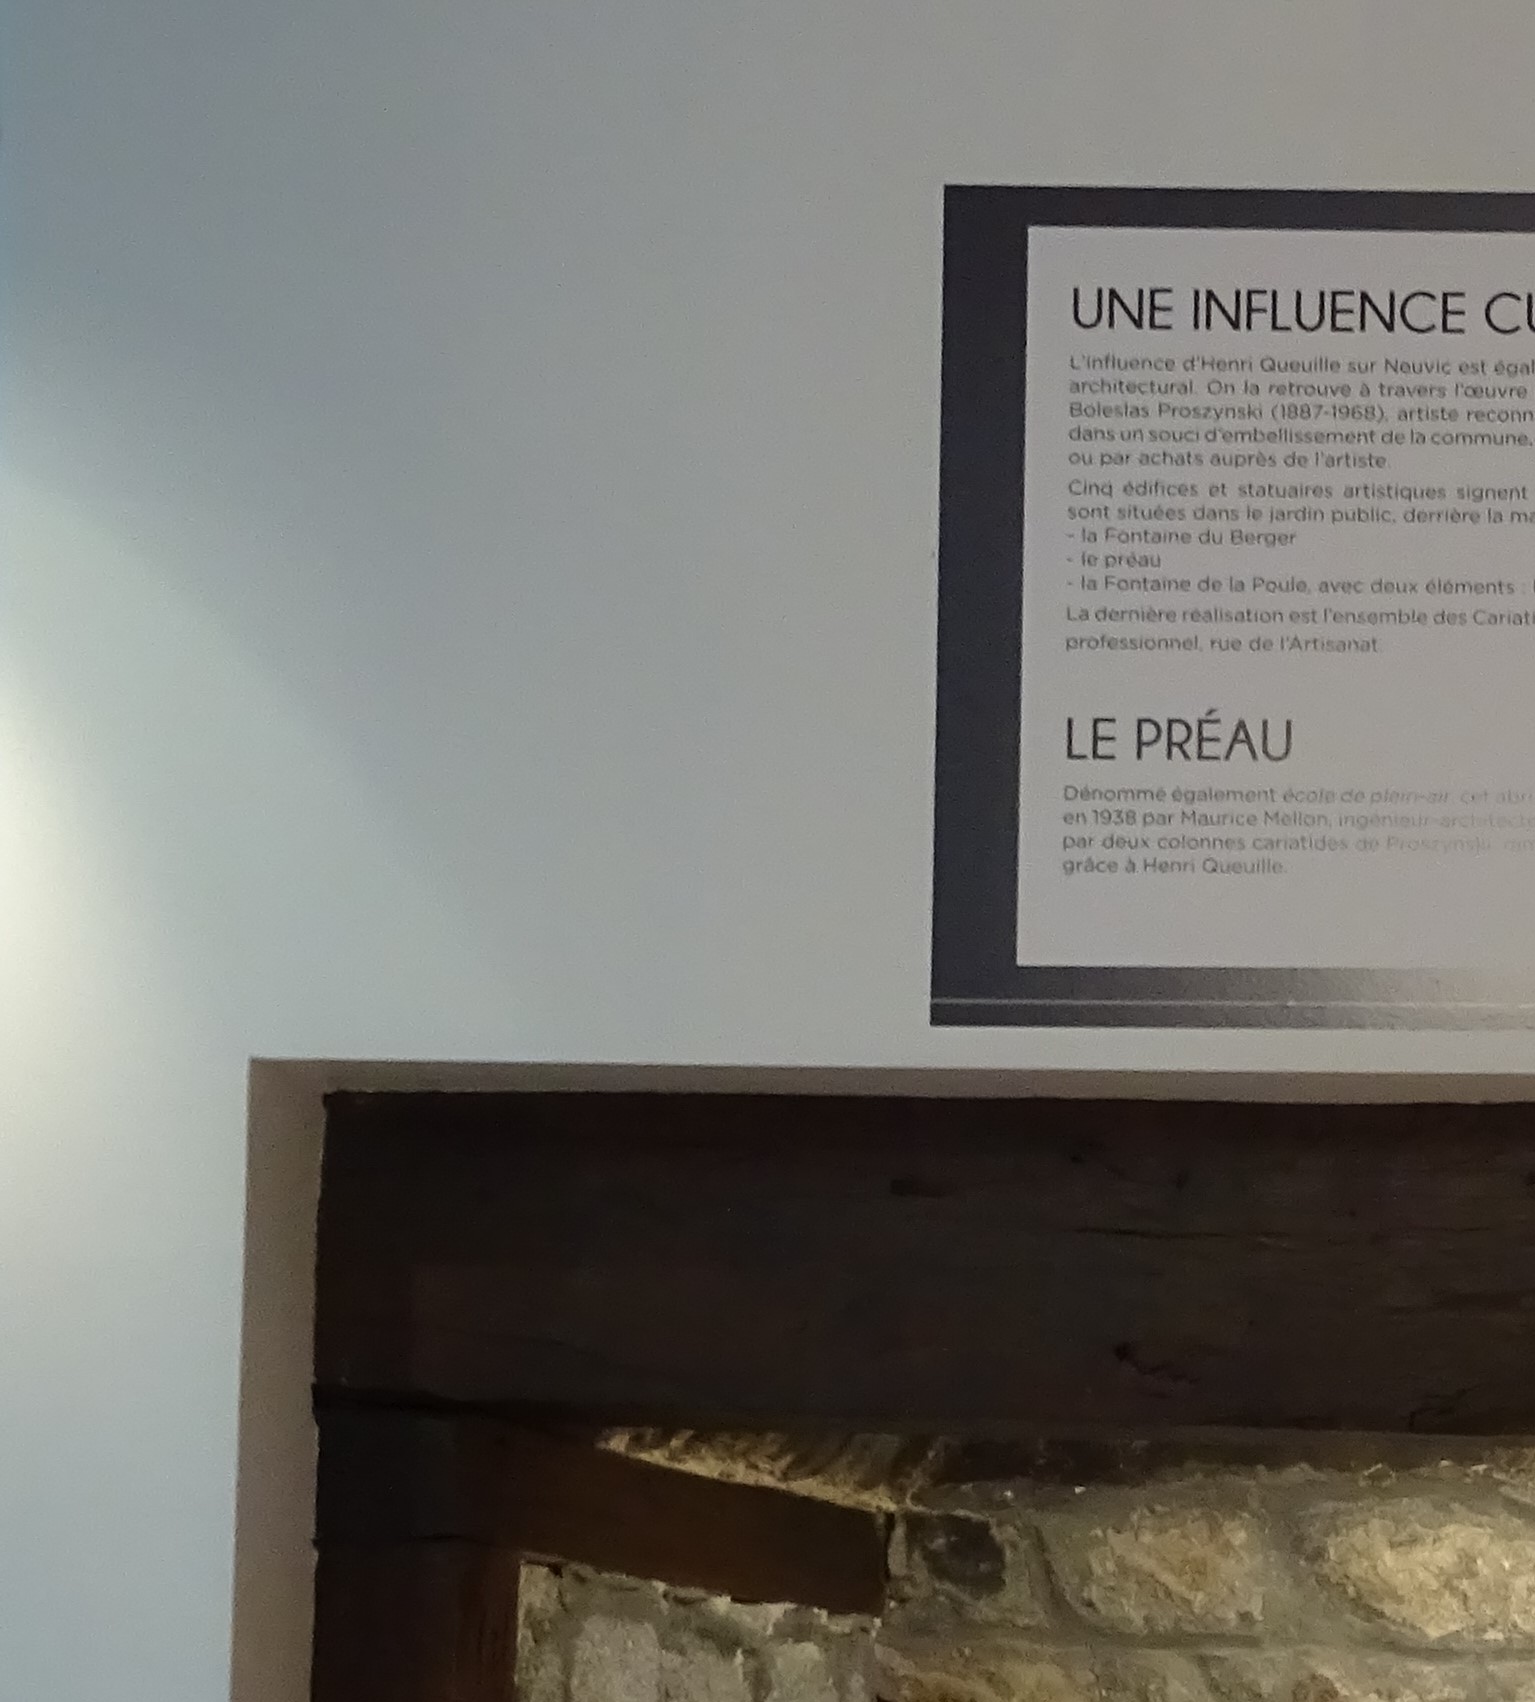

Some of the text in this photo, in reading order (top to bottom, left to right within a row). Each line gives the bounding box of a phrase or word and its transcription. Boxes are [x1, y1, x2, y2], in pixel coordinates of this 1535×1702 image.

[1072, 287, 1173, 330] UNE
[1193, 288, 1466, 334] INFLUENCE
[1069, 352, 1176, 371] L'influence
[1182, 353, 1253, 372] d'Henri
[1259, 354, 1341, 372] Queuille
[1347, 359, 1377, 373] sur
[1384, 355, 1451, 374] Neuvic
[1458, 356, 1487, 374] est
[1081, 525, 1297, 549] la Fontaine du Berger
[1080, 548, 1162, 571] le préau
[1065, 632, 1203, 654] professionnel,
[1209, 637, 1243, 651] rue
[1248, 633, 1274, 651] de
[1066, 708, 1293, 762] LE PRÉAU
